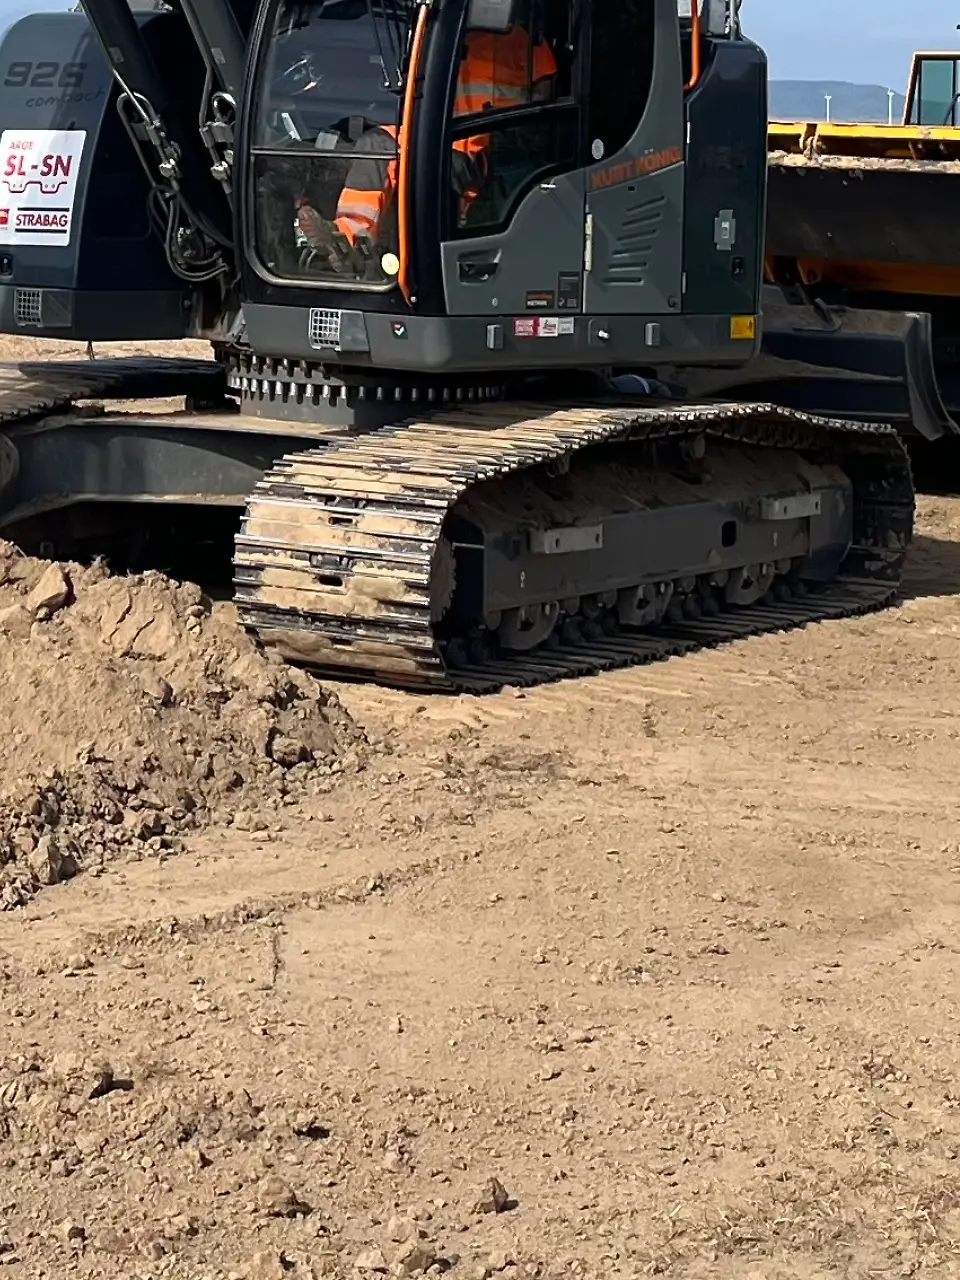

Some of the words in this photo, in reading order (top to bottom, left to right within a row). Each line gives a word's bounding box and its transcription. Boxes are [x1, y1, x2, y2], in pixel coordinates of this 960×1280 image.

[4, 62, 87, 87] 926
[591, 161, 633, 188] KURT
[637, 146, 681, 174] KÖNIG
[16, 213, 68, 227] STRABAG
